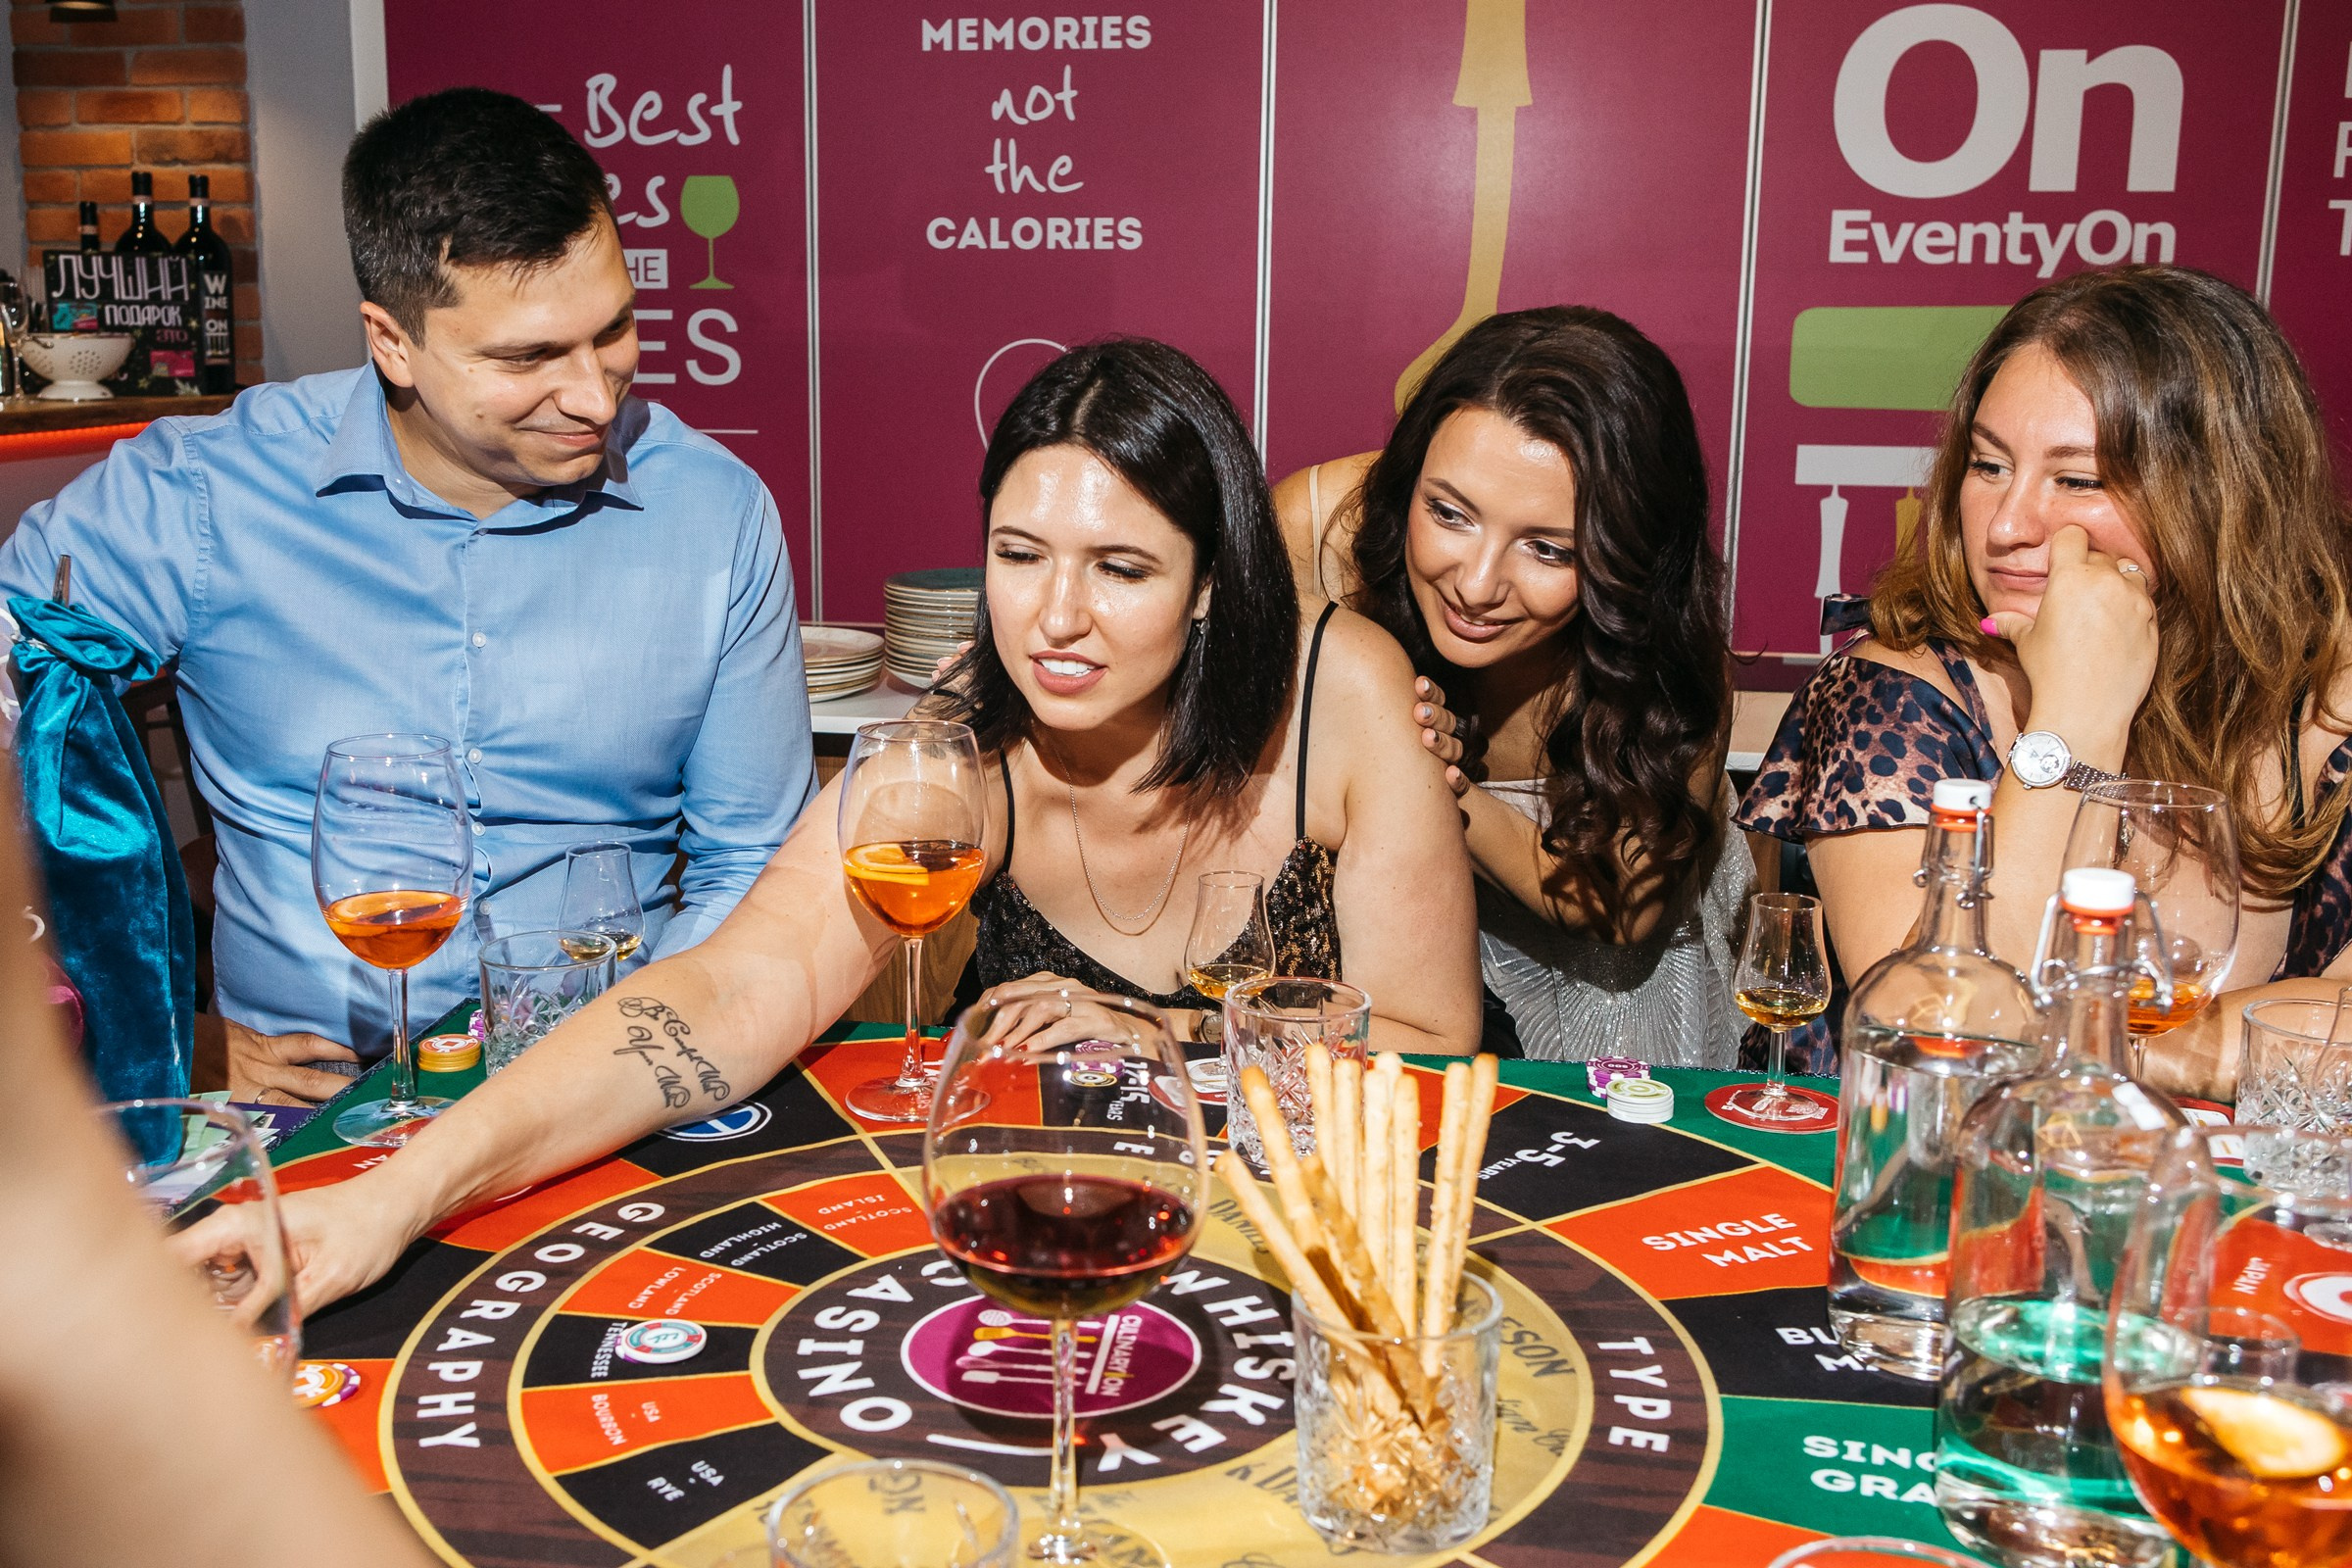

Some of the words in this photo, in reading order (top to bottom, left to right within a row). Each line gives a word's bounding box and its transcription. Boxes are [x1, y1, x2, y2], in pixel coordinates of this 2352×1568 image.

[921, 15, 1152, 51] MEMORIES
[584, 64, 743, 148] Best
[992, 64, 1078, 124] not
[1833, 3, 2184, 199] On
[984, 137, 1084, 194] the
[926, 217, 1143, 250] CALORIES
[1828, 209, 2177, 278] EventyOn
[52, 254, 189, 301] ЛУЧШИЙ
[105, 304, 182, 326] ПОДАРОК
[1515, 1131, 1601, 1167] 3-5
[817, 1194, 886, 1214] ISLAND
[823, 1206, 912, 1231] SCOTLAND
[699, 1222, 782, 1258] HIGHLAND
[731, 1233, 808, 1267] SCOTLAND
[1642, 1213, 1797, 1250] SINGLE
[1701, 1236, 1813, 1267] MALT
[628, 1267, 686, 1309] LOWLAND
[665, 1273, 722, 1316] SCOTLAND
[416, 1201, 665, 1448] GEOGRAPHY
[591, 1321, 628, 1378] TENNESSEE
[797, 1259, 968, 1432] CASINO
[1098, 1270, 1296, 1472] WHISKEY
[641, 1401, 662, 1423] USA
[1597, 1337, 1671, 1452] TYPE
[591, 1394, 627, 1446] BOURBON
[1802, 1435, 1937, 1472] SIN
[647, 1476, 685, 1501] RYE
[691, 1460, 724, 1487] USA
[1810, 1468, 1939, 1507] GRA
